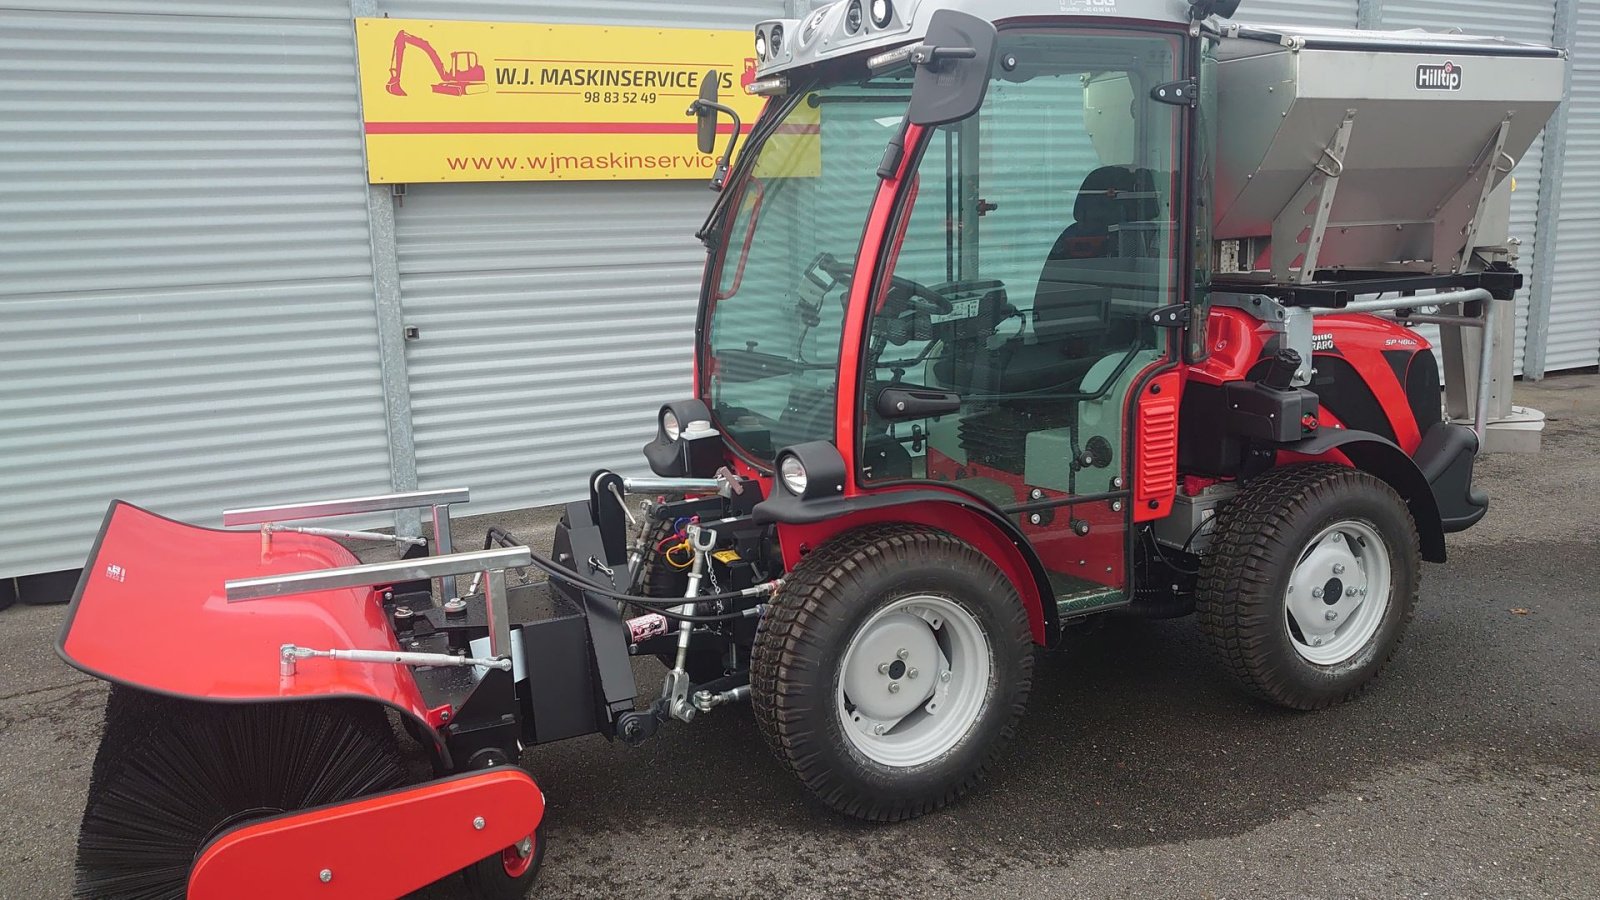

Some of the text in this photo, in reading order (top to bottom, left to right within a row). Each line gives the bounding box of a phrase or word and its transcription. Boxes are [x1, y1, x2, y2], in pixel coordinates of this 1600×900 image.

[496, 68, 534, 85] W.J.
[540, 68, 698, 88] MASKINSERVICE
[1419, 68, 1459, 91] Hilltip
[584, 91, 657, 104] 98 83 52 49
